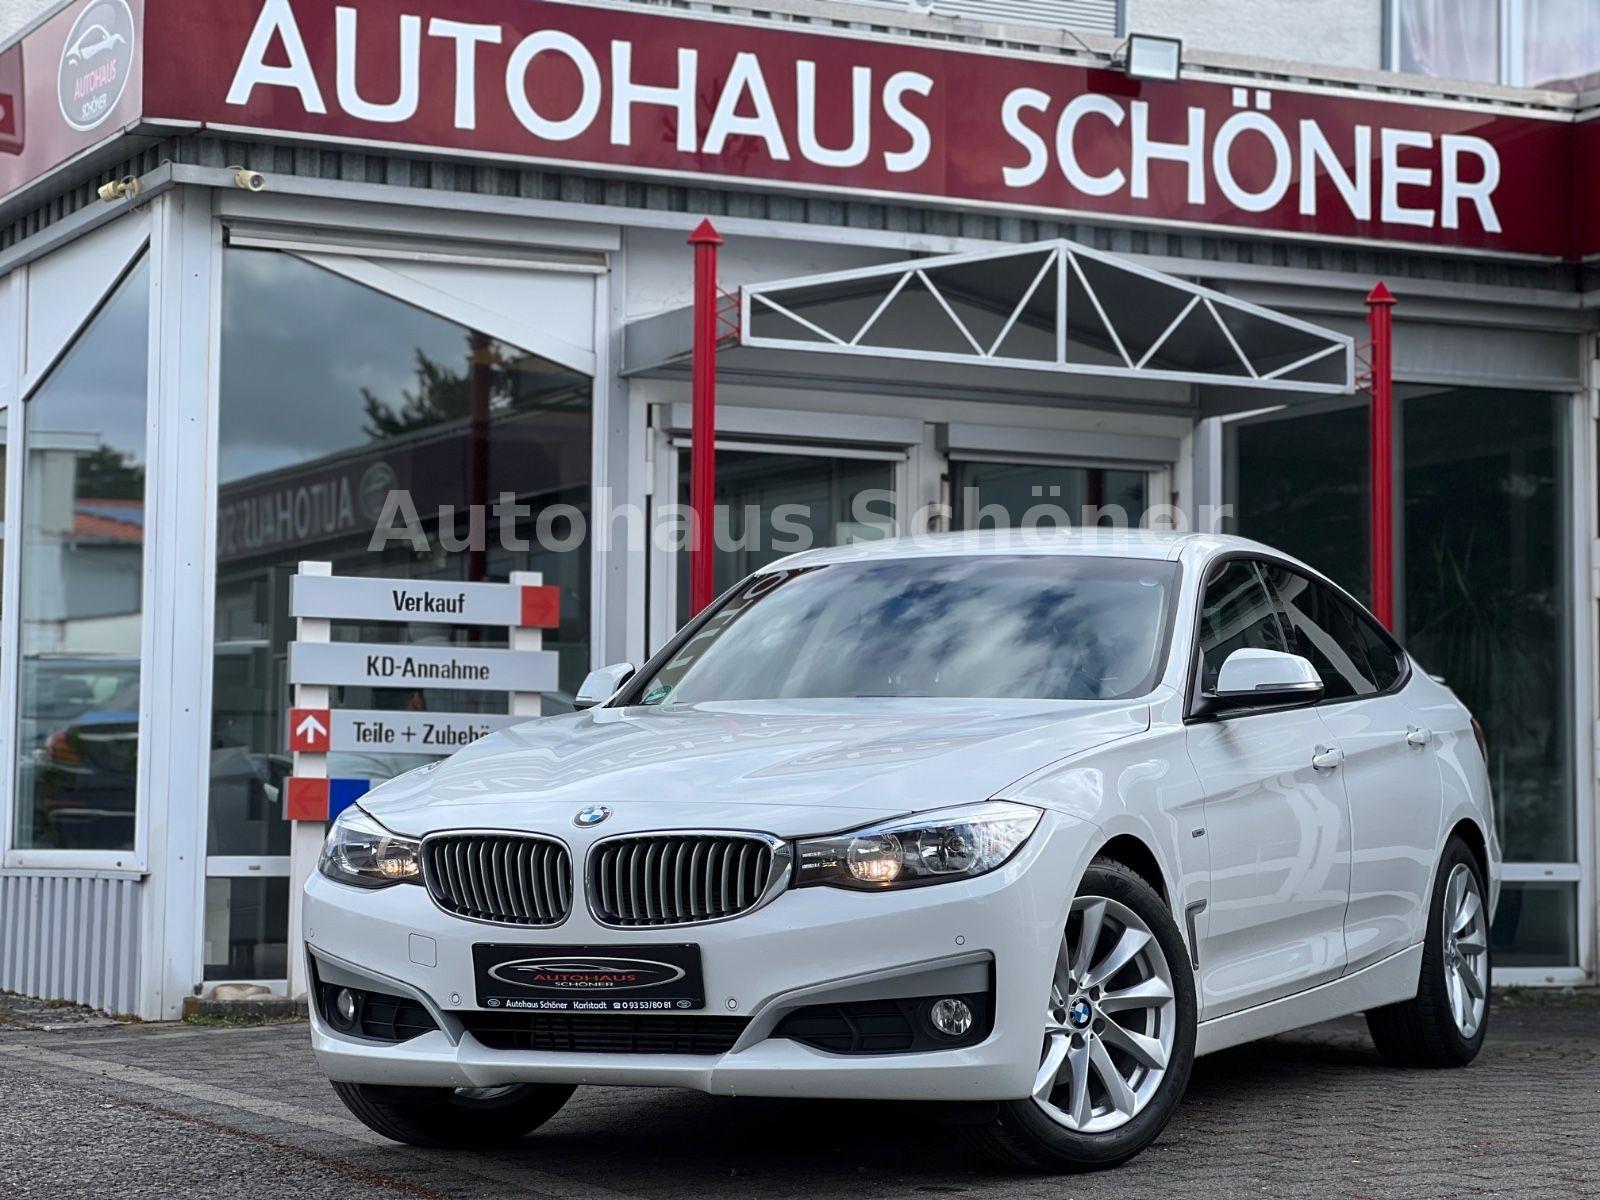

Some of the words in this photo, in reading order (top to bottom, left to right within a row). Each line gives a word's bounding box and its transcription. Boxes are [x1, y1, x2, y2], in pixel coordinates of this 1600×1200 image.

[73, 58, 117, 101] AUTOHAUS
[226, 0, 934, 172] AUTOHAUS
[1001, 87, 1502, 233] SCHÖNER
[392, 590, 465, 614] Verkauf
[367, 655, 490, 681] KD-Annahme
[353, 721, 395, 743] Teile
[401, 725, 416, 743] +
[506, 999, 538, 1009] Autohaus
[540, 1000, 567, 1009] Schöner
[573, 1001, 607, 1010] Karlstadt
